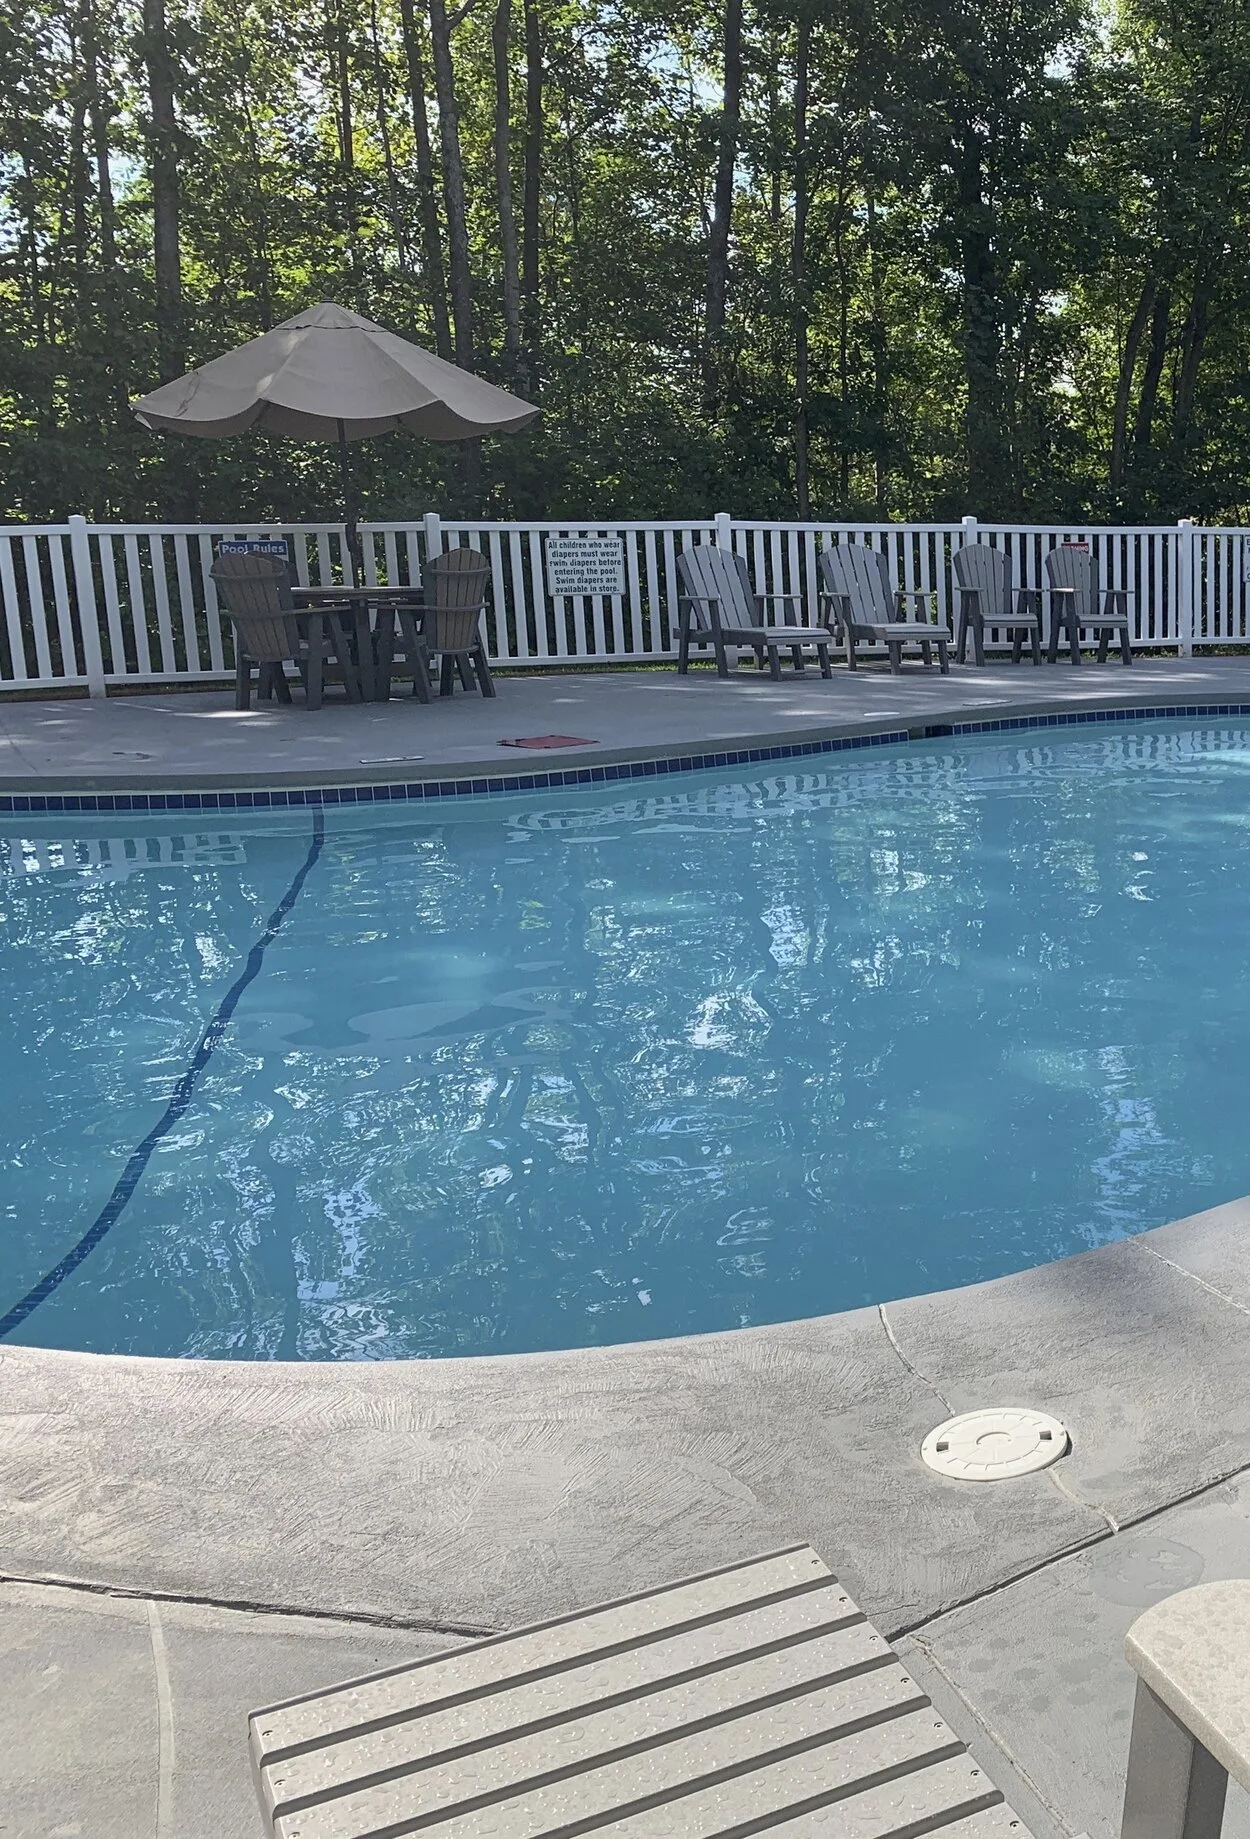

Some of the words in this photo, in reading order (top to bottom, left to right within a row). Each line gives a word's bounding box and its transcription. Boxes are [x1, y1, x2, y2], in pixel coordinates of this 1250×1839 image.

[222, 544, 248, 554] Pool
[253, 544, 284, 553] Rules
[552, 550, 578, 558] diapers
[554, 568, 585, 576] entering
